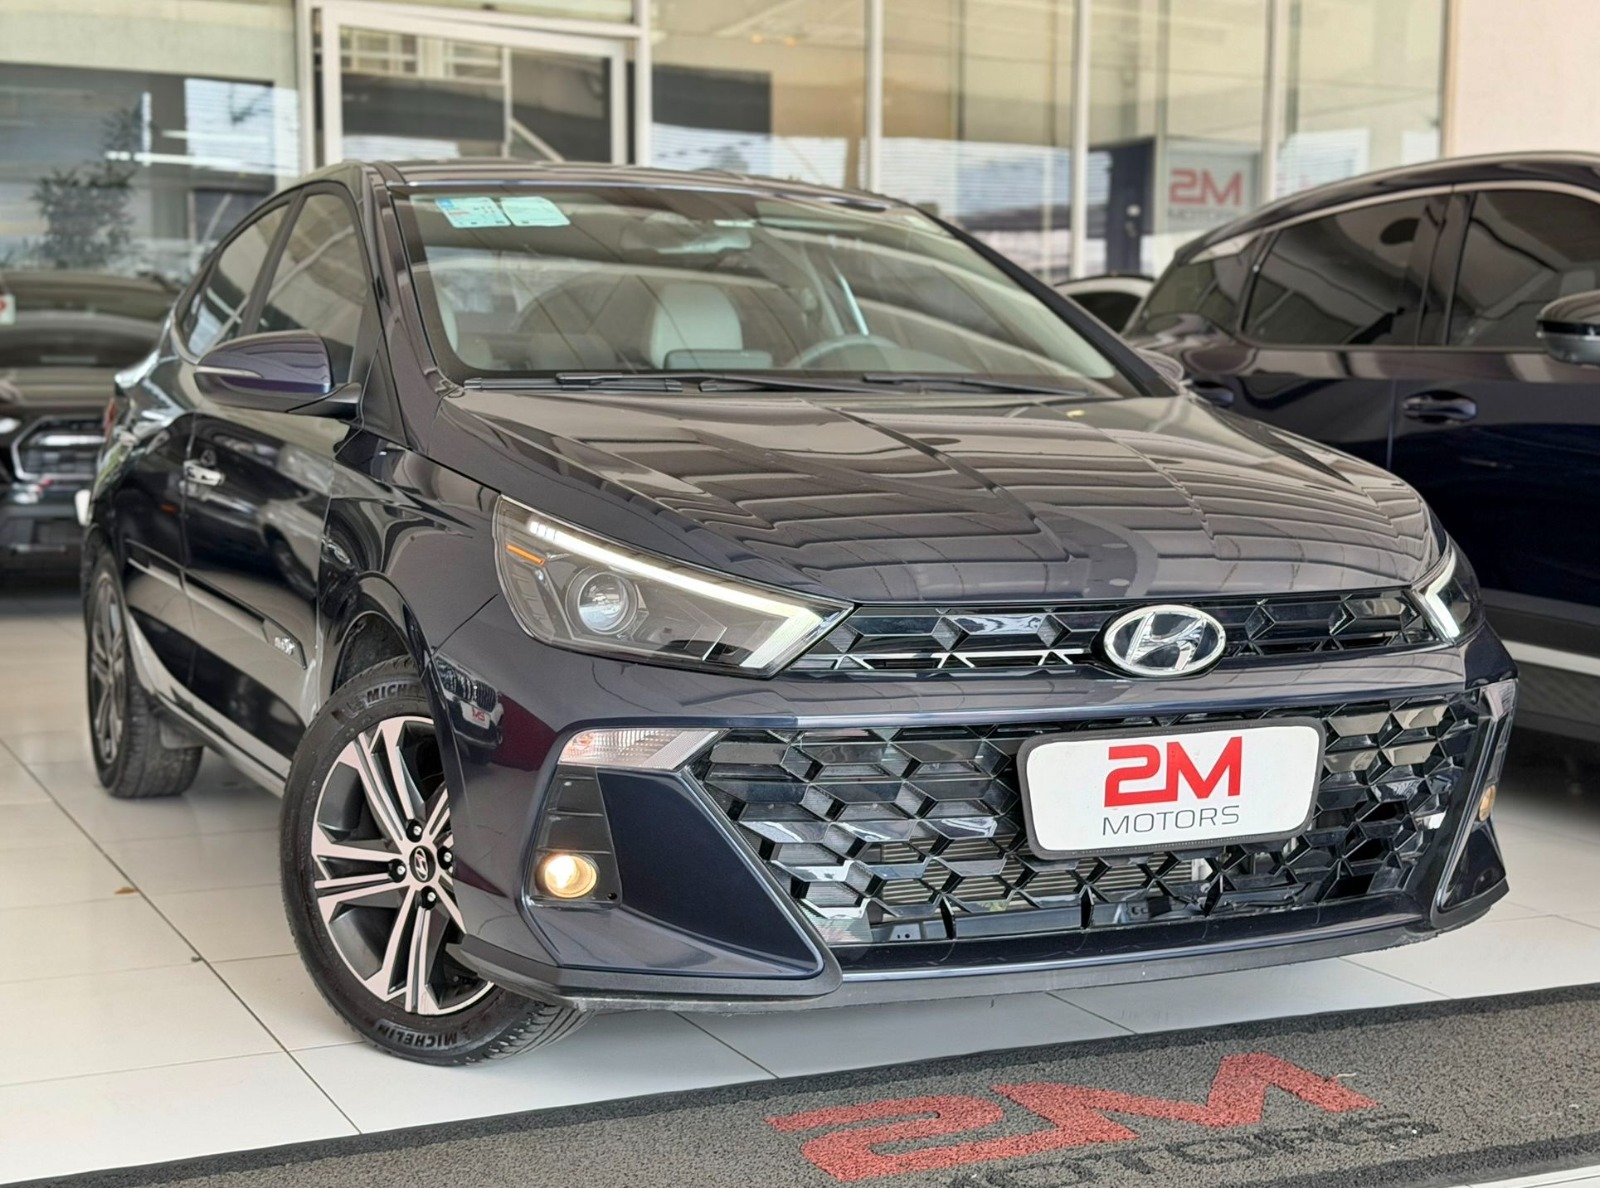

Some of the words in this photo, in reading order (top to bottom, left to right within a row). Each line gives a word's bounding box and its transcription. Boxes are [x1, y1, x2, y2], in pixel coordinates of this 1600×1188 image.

[1168, 168, 1243, 207] 2M
[1104, 736, 1243, 807] 2M
[1102, 805, 1240, 836] MOTORS
[377, 1022, 458, 1048] MICHELIN
[762, 1051, 1379, 1183] 2M
